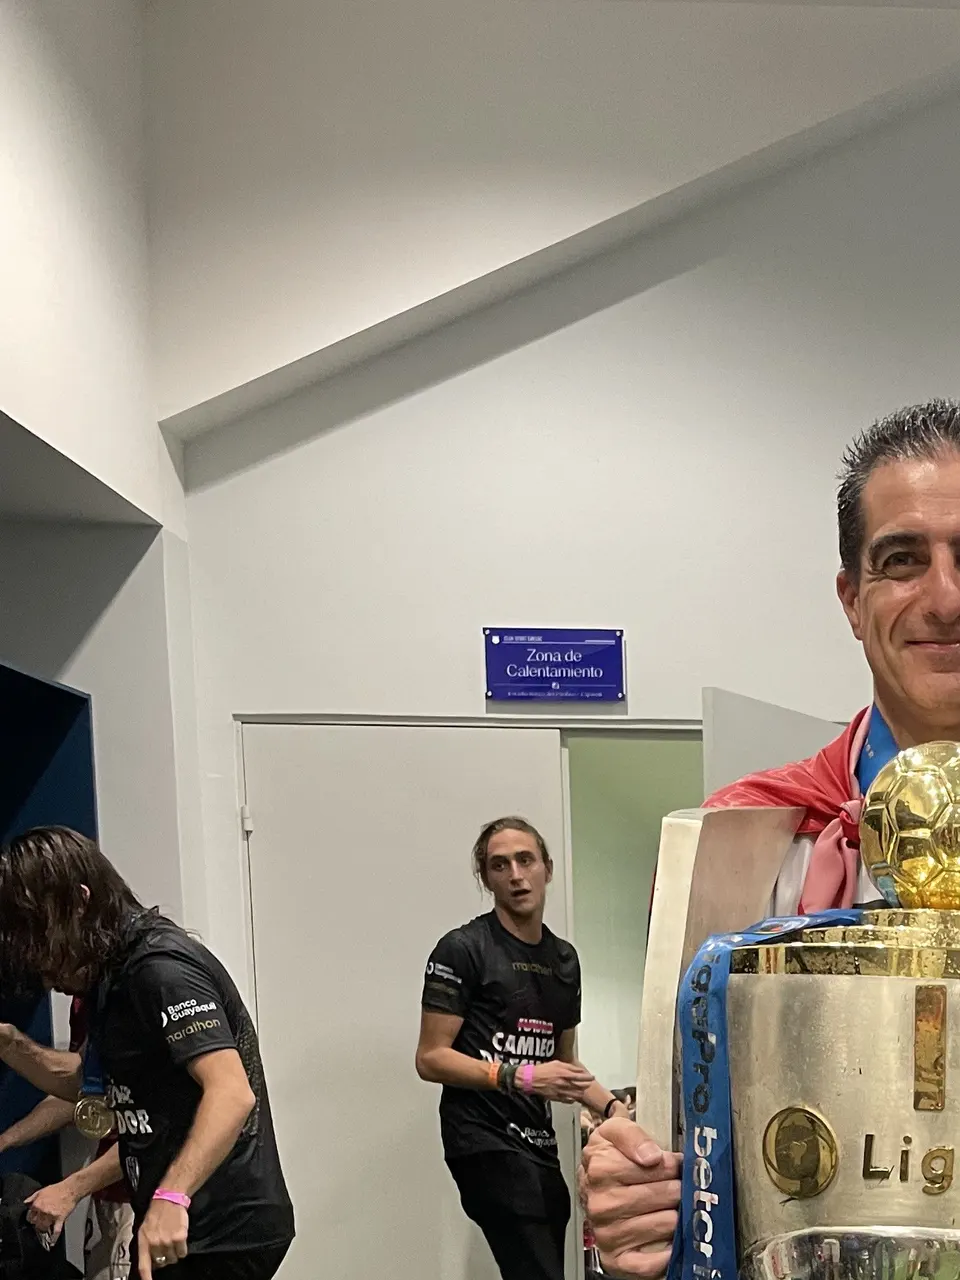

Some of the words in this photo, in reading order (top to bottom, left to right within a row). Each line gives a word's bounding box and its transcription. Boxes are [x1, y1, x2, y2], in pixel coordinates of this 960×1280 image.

[527, 648, 562, 662] Zona
[564, 649, 582, 662] de
[506, 664, 604, 678] Calentamiento
[167, 999, 197, 1015] Banco
[170, 1001, 217, 1021] Guayaquil
